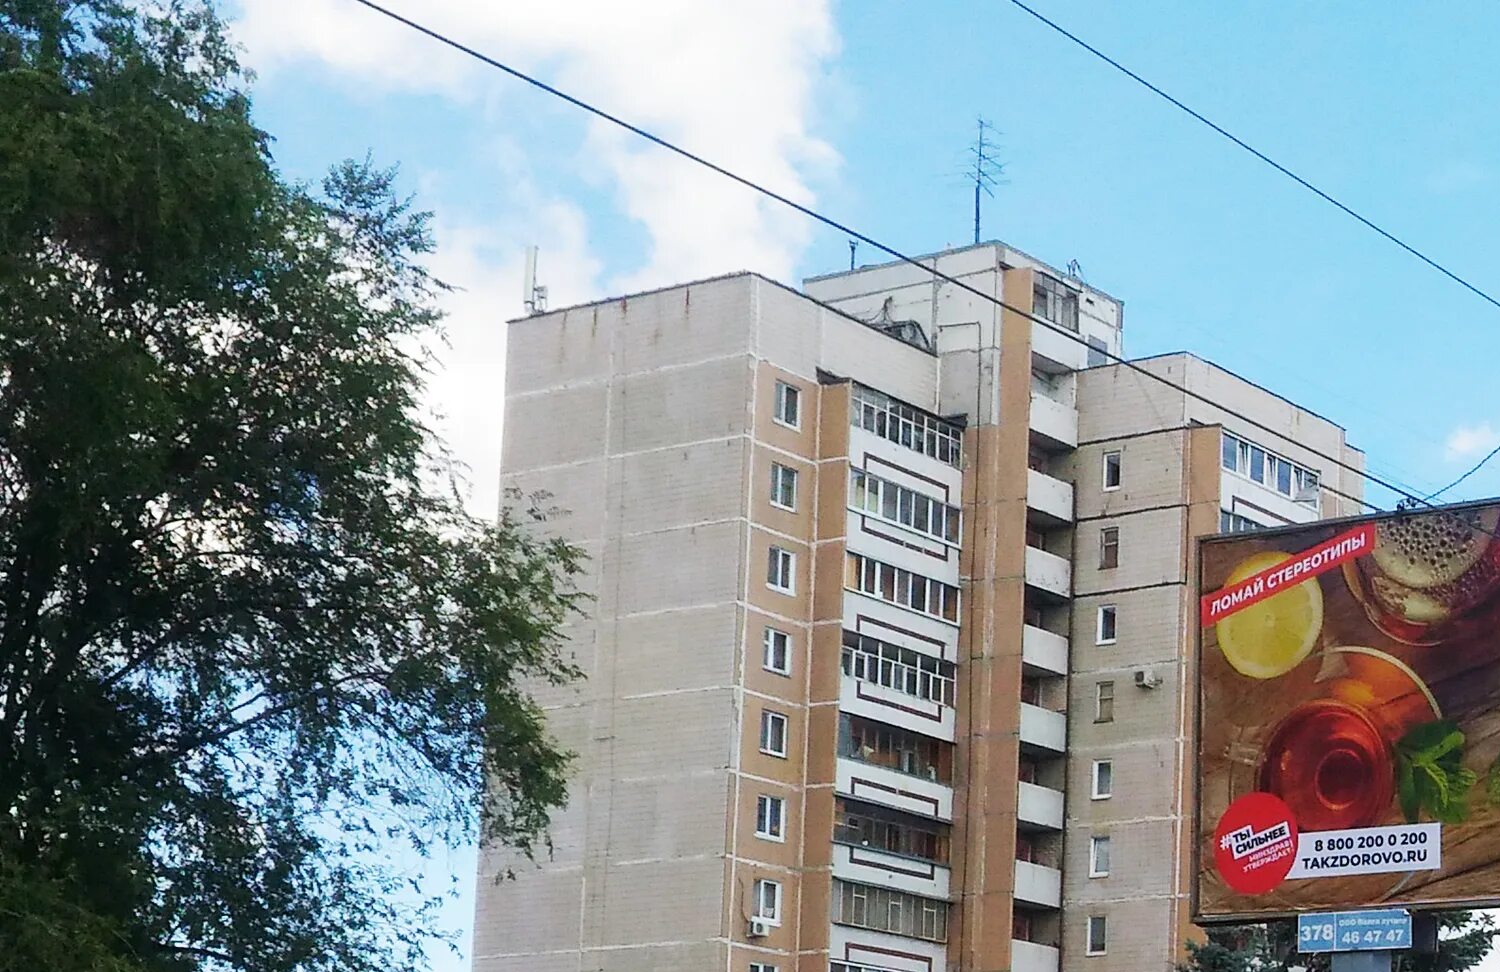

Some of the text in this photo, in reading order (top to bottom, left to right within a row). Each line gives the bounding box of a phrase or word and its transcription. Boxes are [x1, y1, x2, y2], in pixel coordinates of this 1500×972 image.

[1211, 532, 1366, 616] ЛОМАЙ СТЕРЕОТИПЫ
[1235, 826, 1287, 854] СИЛЬНЕЕ
[1314, 832, 1428, 852] 8 800 200 0 200
[1302, 849, 1428, 870] TAKZDOROVO.RU
[1300, 924, 1334, 942] 378
[1342, 929, 1404, 944] 46 47 47
